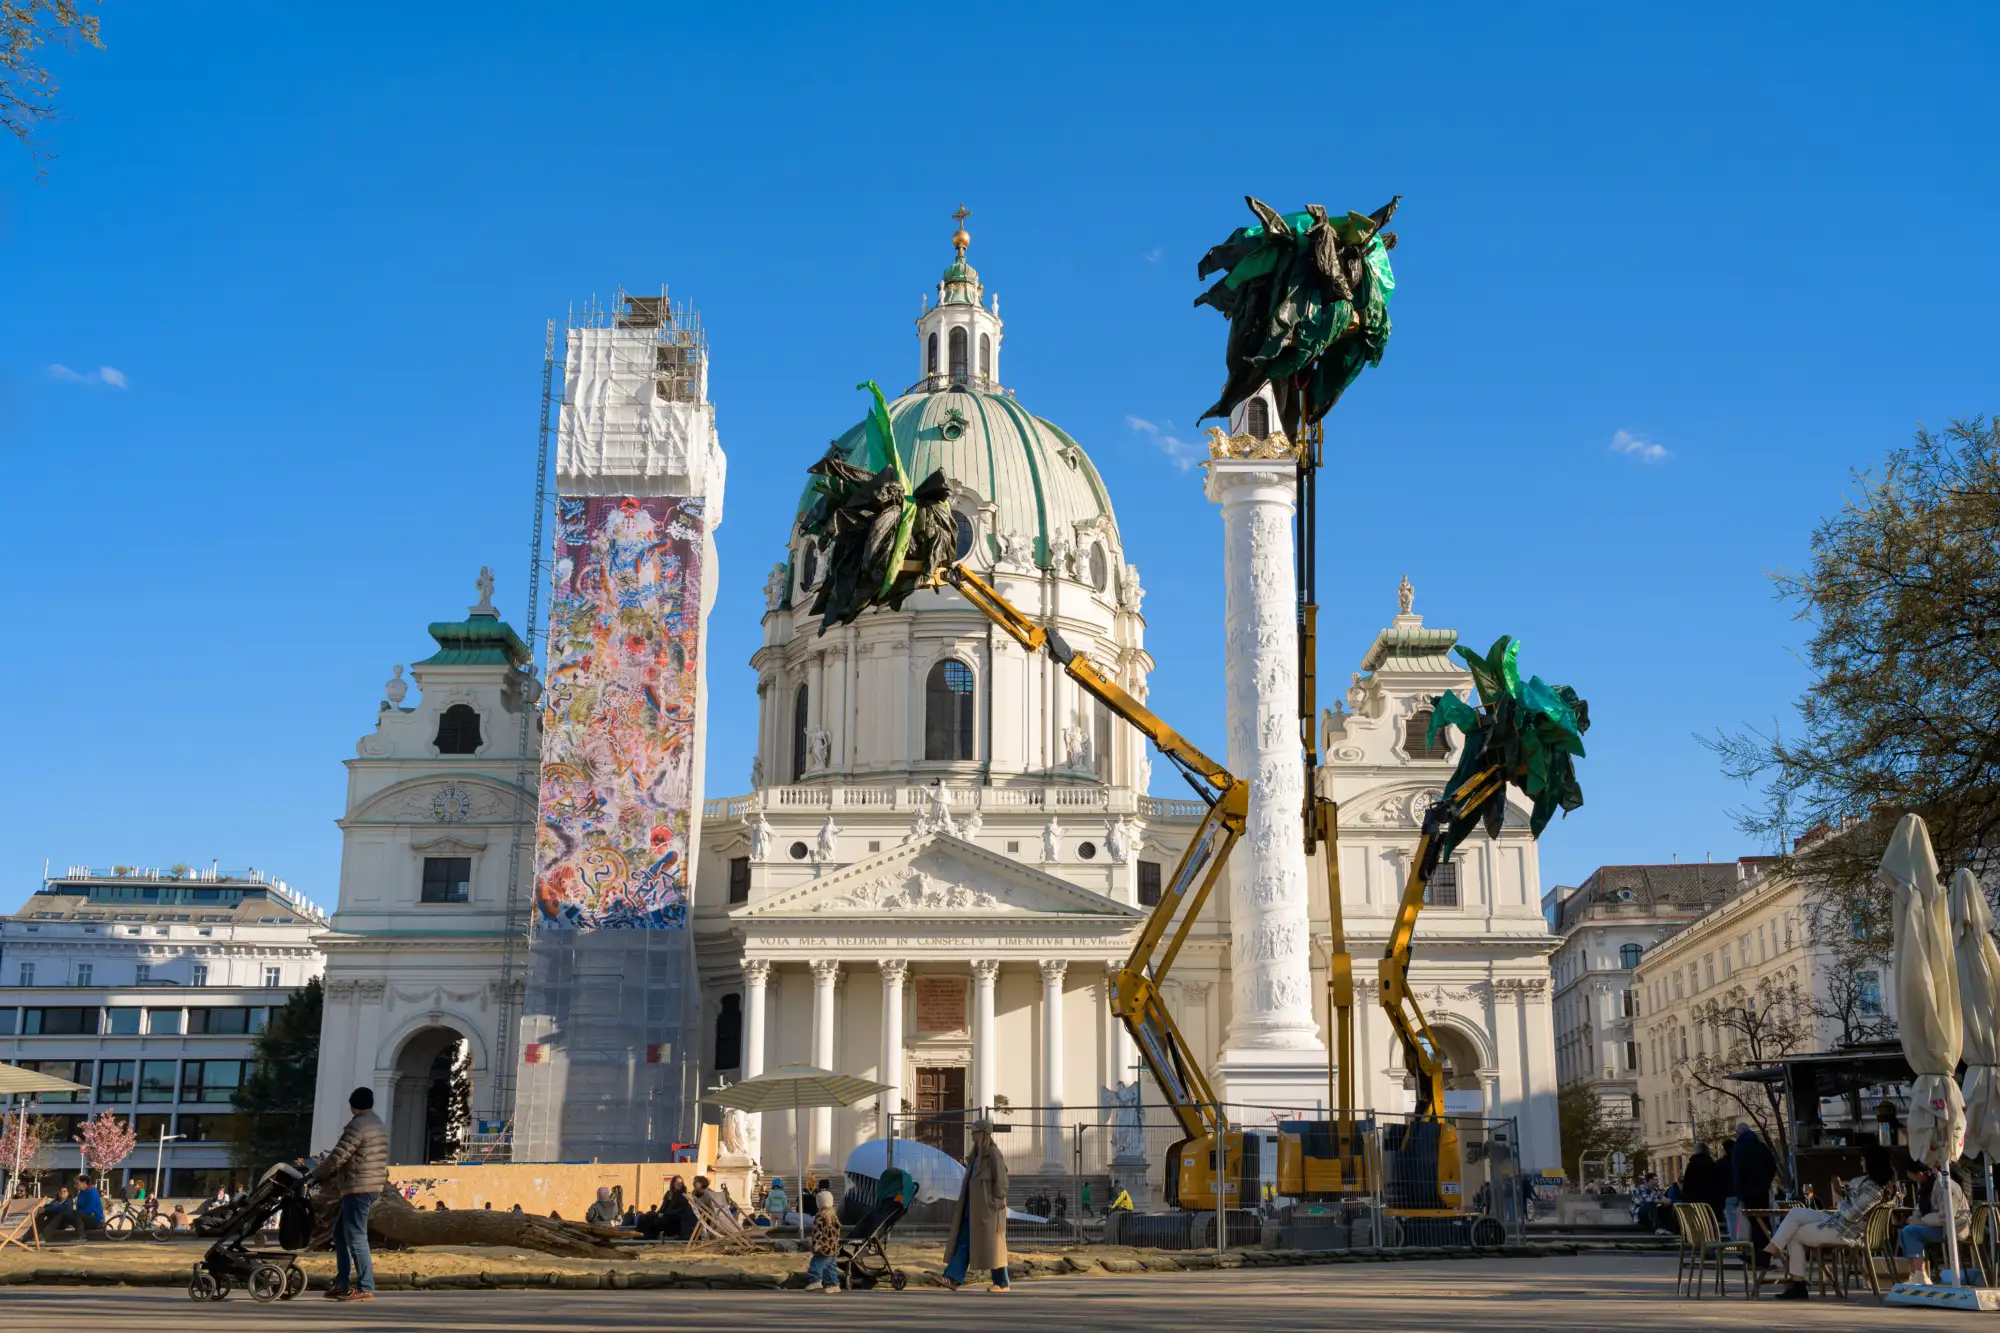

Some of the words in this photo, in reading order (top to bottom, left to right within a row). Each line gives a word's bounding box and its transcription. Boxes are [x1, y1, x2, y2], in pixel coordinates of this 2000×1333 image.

[760, 936, 790, 946] VOTA
[799, 936, 827, 946] MEA
[837, 936, 888, 946] REDDAM
[896, 936, 908, 946] IN
